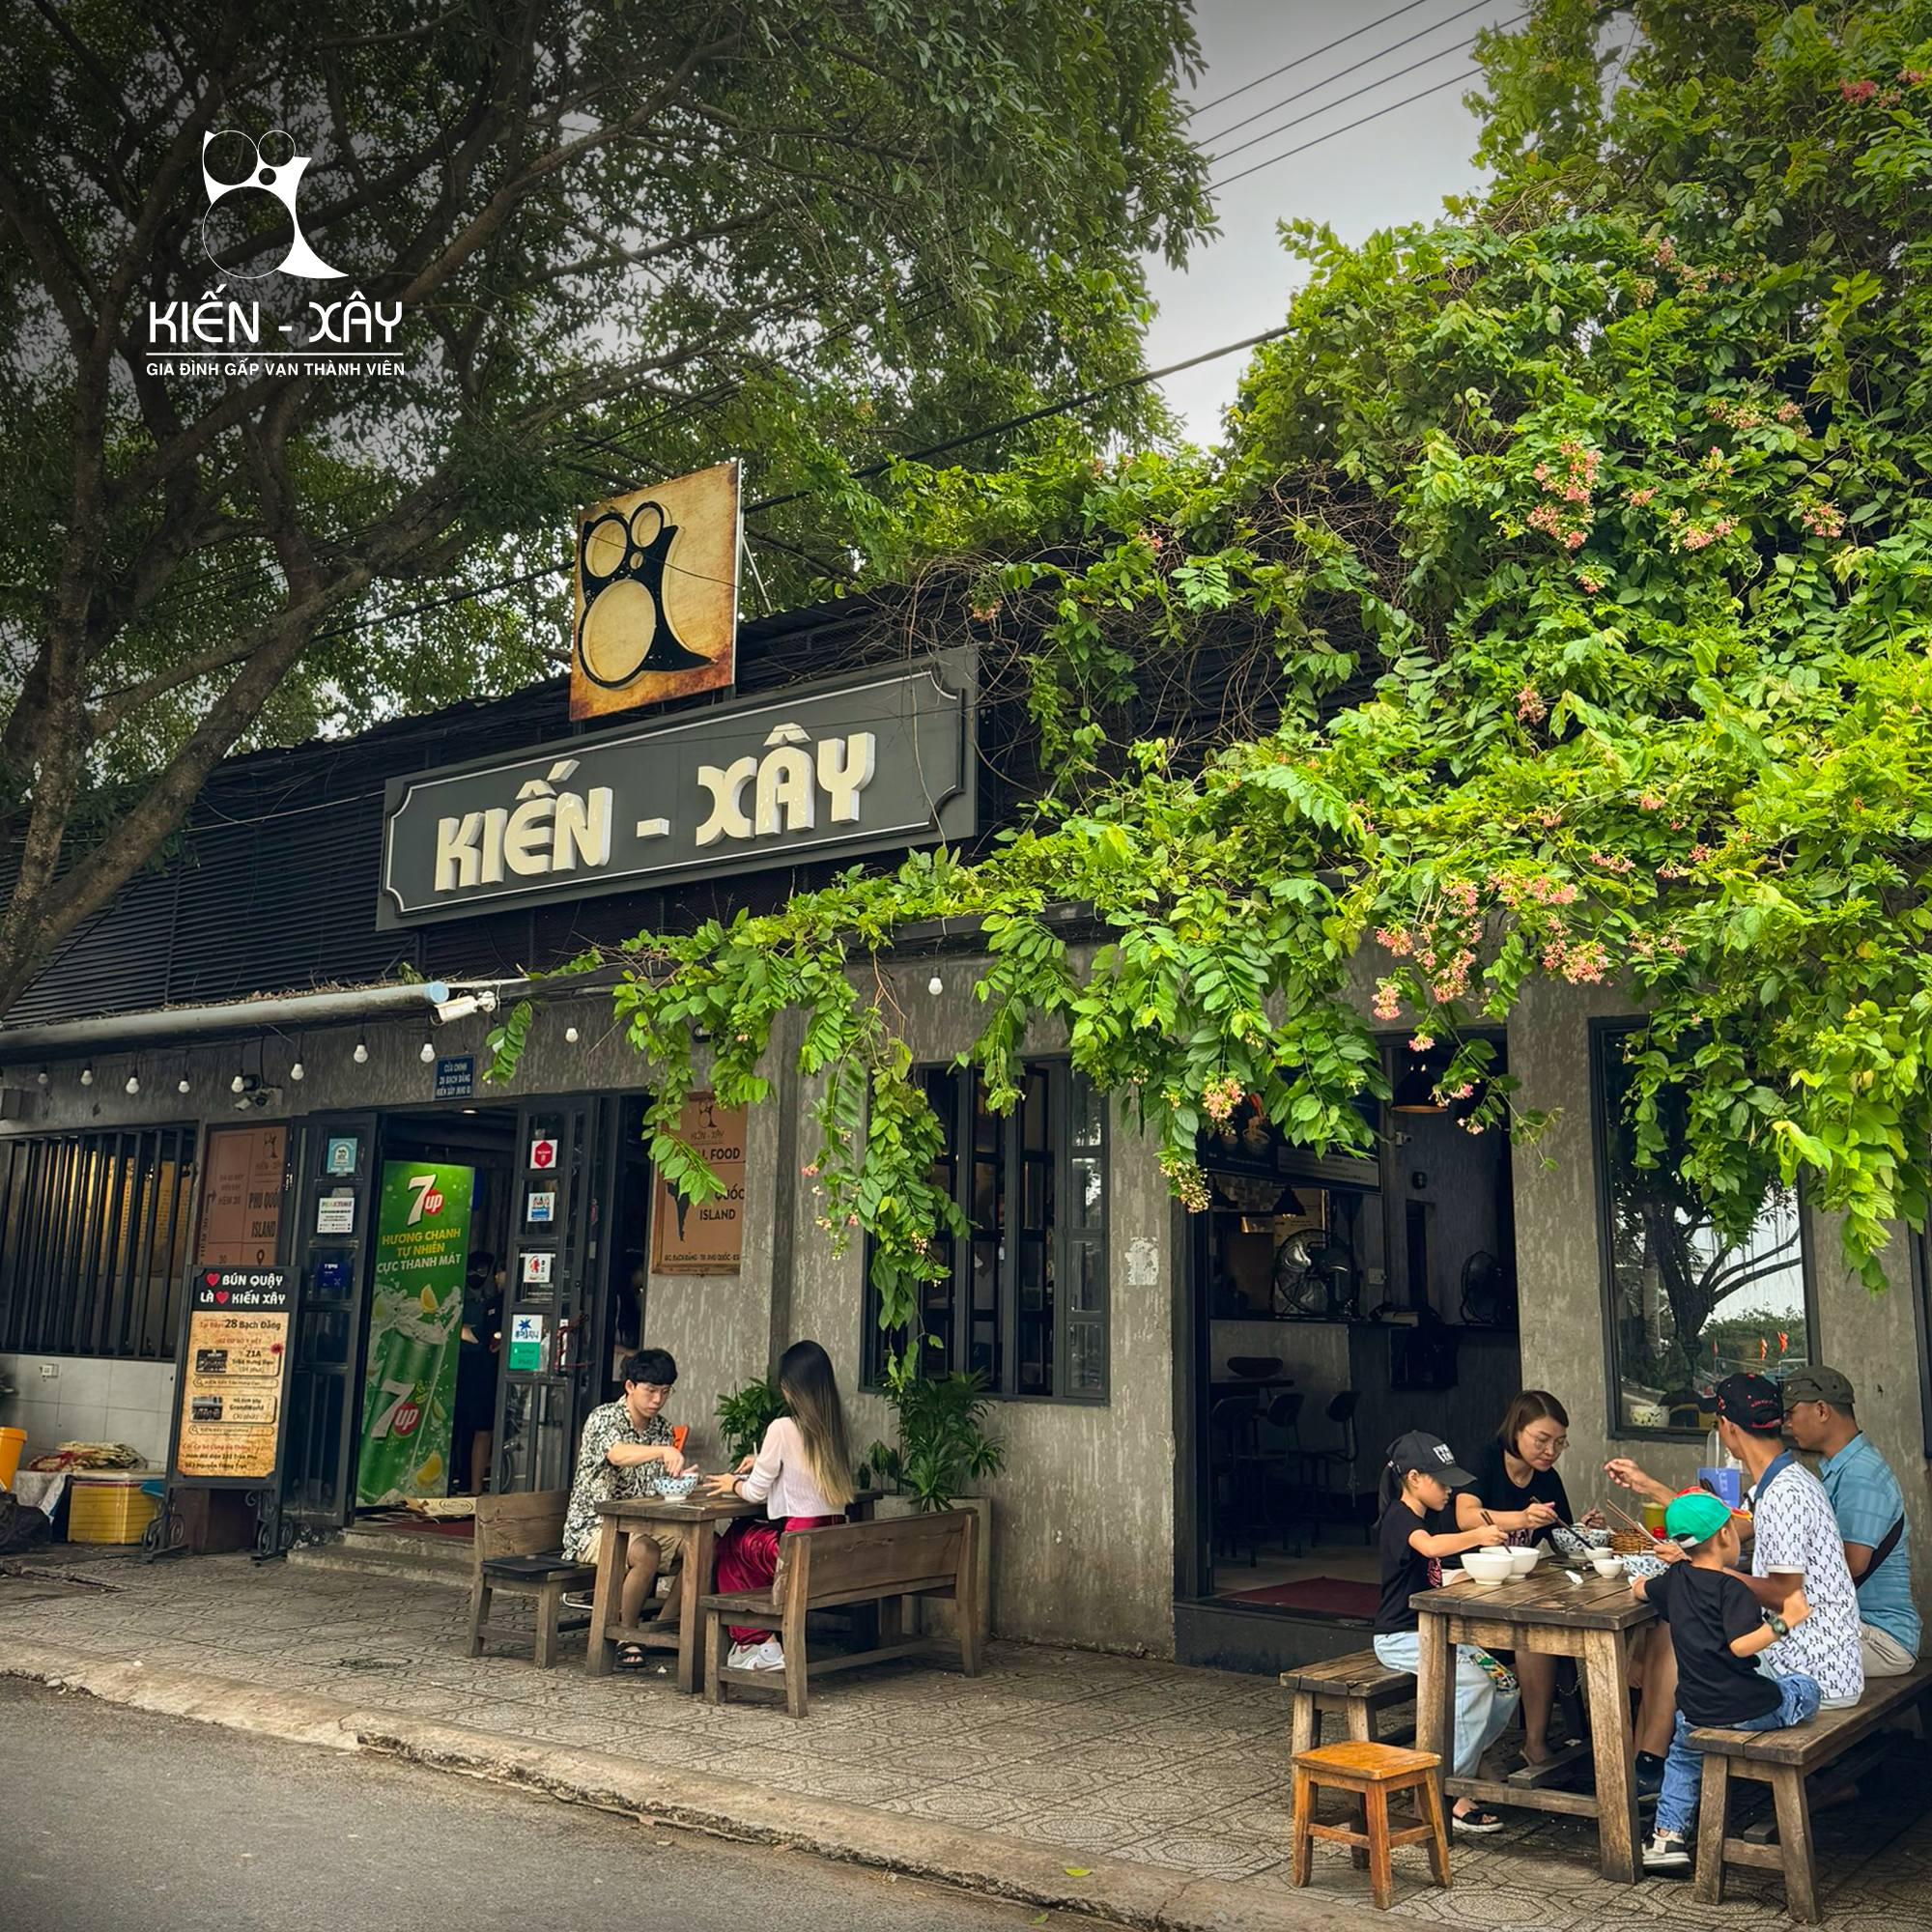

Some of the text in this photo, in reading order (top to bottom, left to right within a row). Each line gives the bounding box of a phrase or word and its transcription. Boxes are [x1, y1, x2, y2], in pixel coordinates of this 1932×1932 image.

[435, 758, 612, 892] KIẾN
[696, 723, 875, 847] XÂY
[710, 1148, 740, 1160] FOOD
[699, 1208, 736, 1221] ISLAND
[382, 1228, 462, 1246] HƯƠNG CHANH
[397, 1240, 445, 1260] TỰ NHIÊN
[377, 1251, 462, 1275] CỰC THANH MÁT
[221, 1272, 283, 1289] BÚN QUẬY
[200, 1289, 286, 1305] LÀ KIẾN XÂY
[225, 1319, 239, 1329] 28
